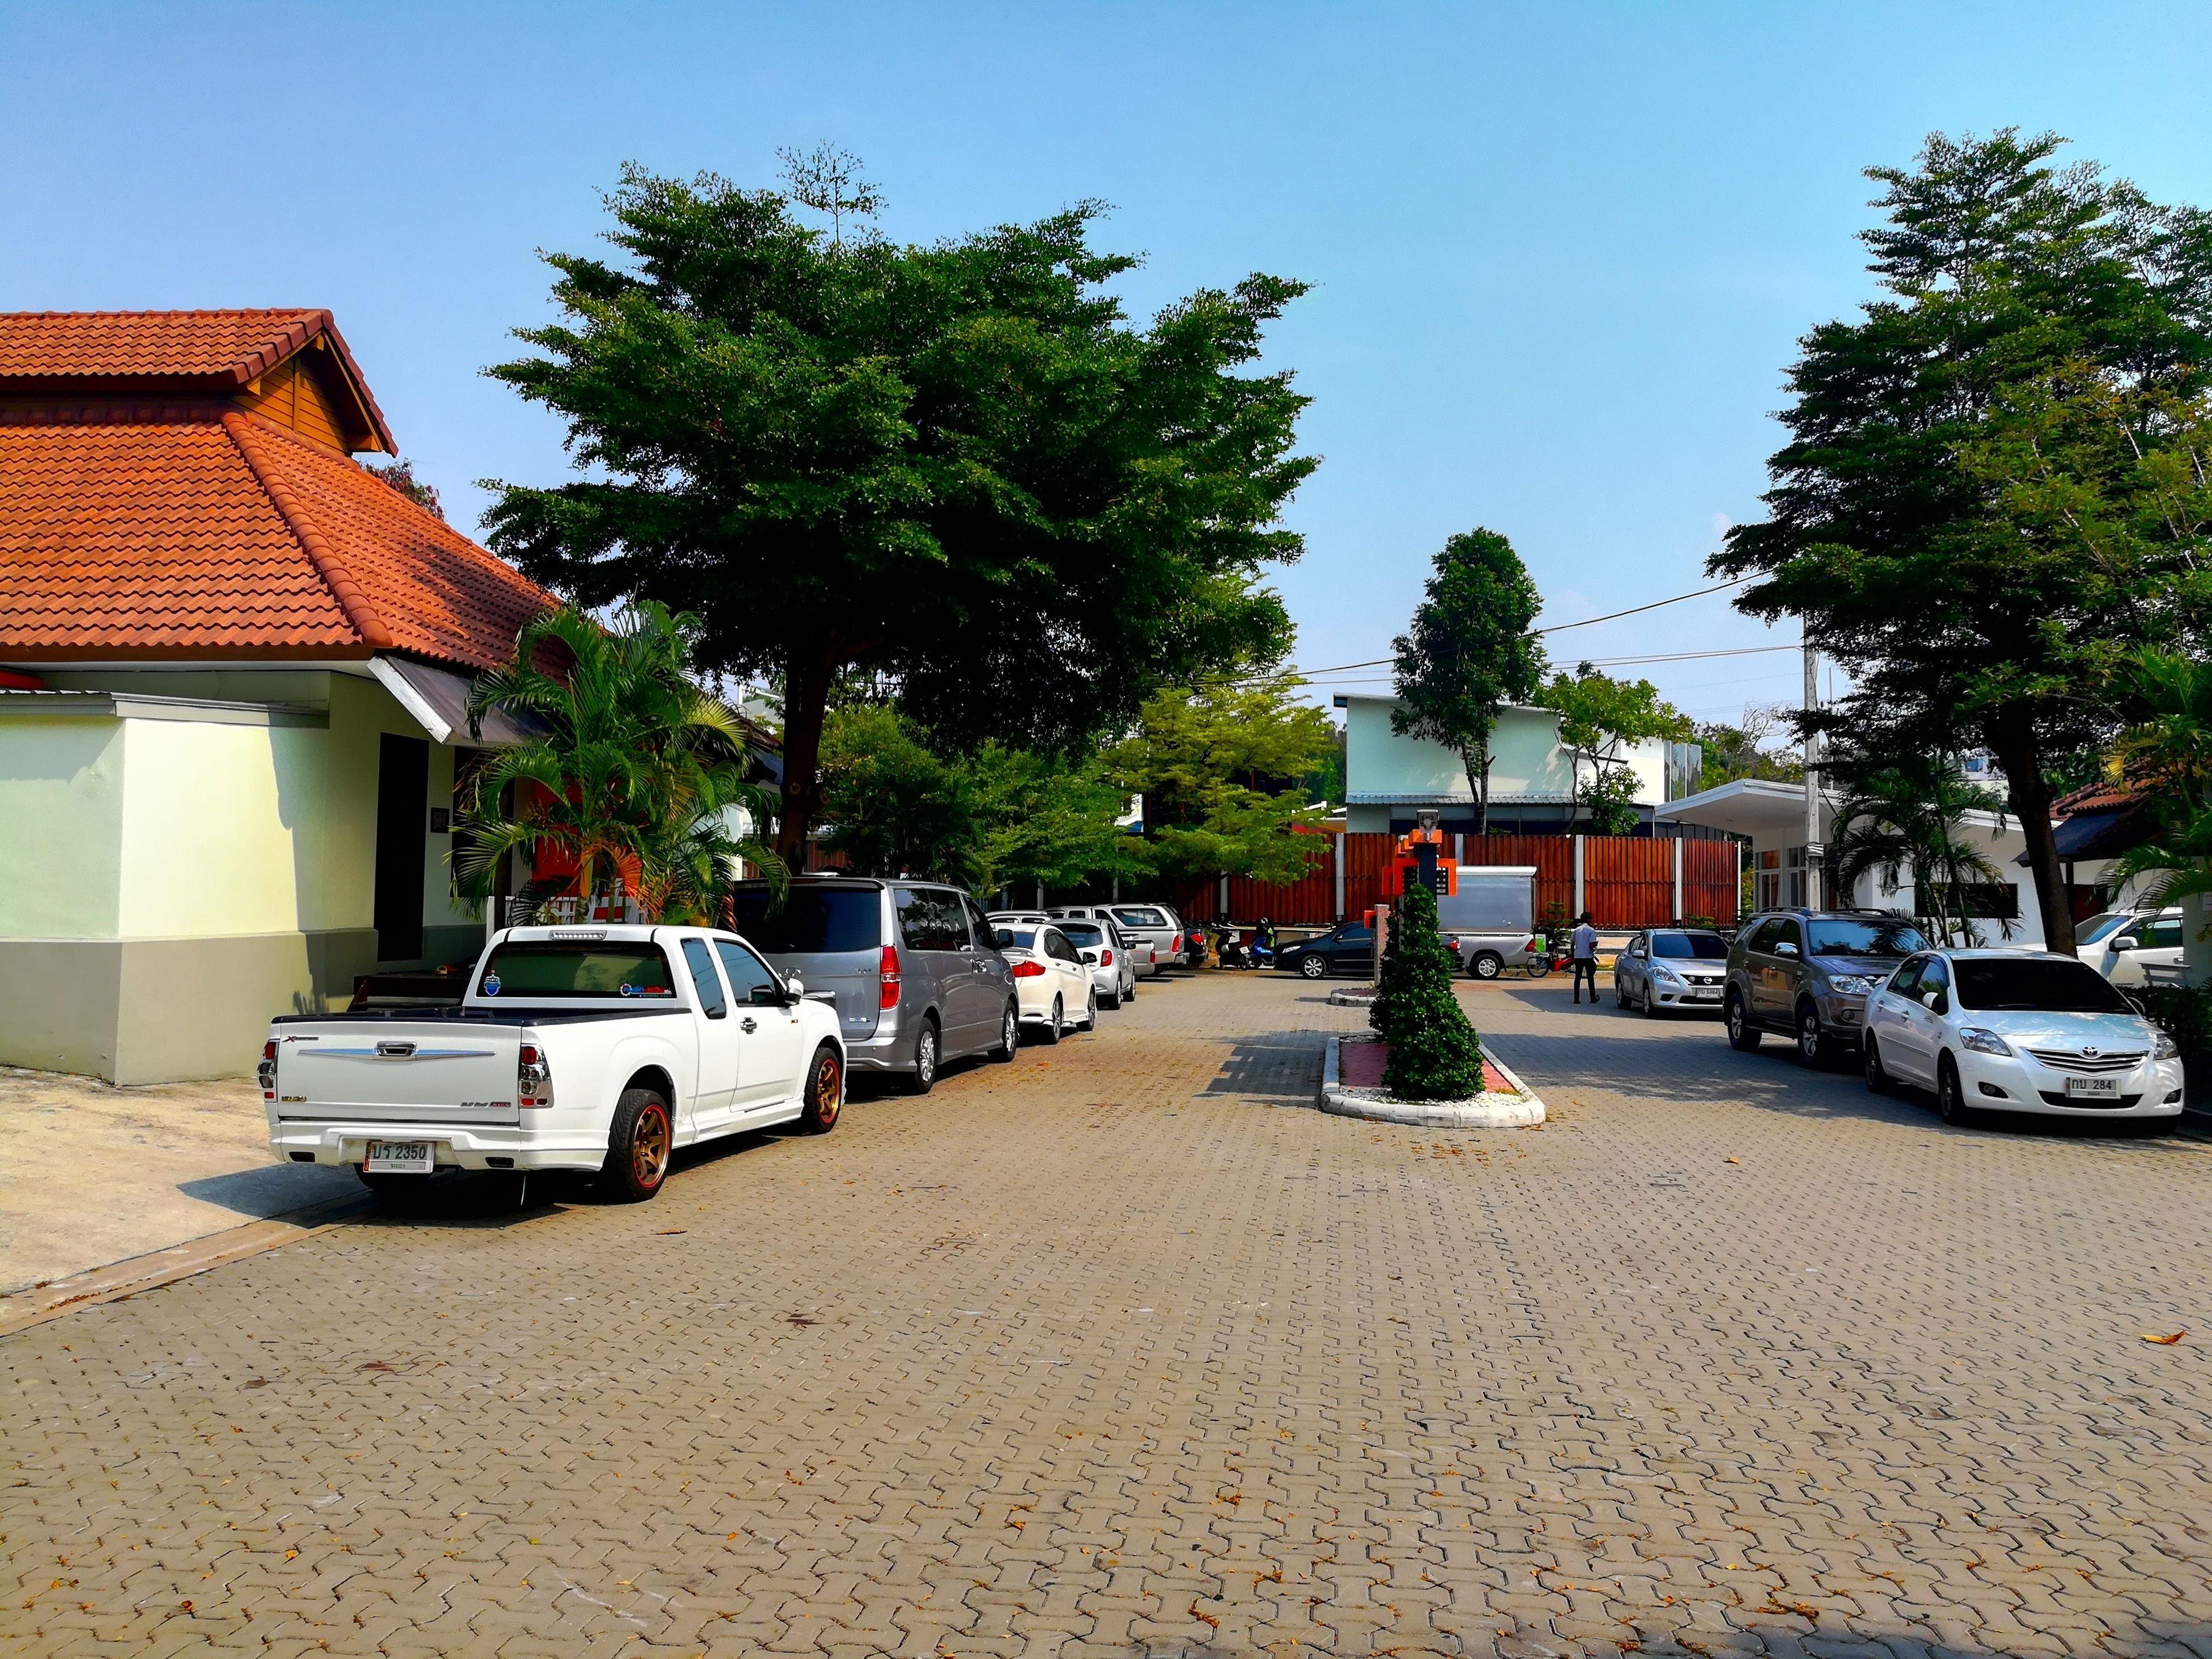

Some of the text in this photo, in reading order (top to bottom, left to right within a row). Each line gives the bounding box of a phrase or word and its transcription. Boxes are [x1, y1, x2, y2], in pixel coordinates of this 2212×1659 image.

[2093, 1080, 2112, 1090] 284
[373, 1145, 426, 1160] บร 2350
